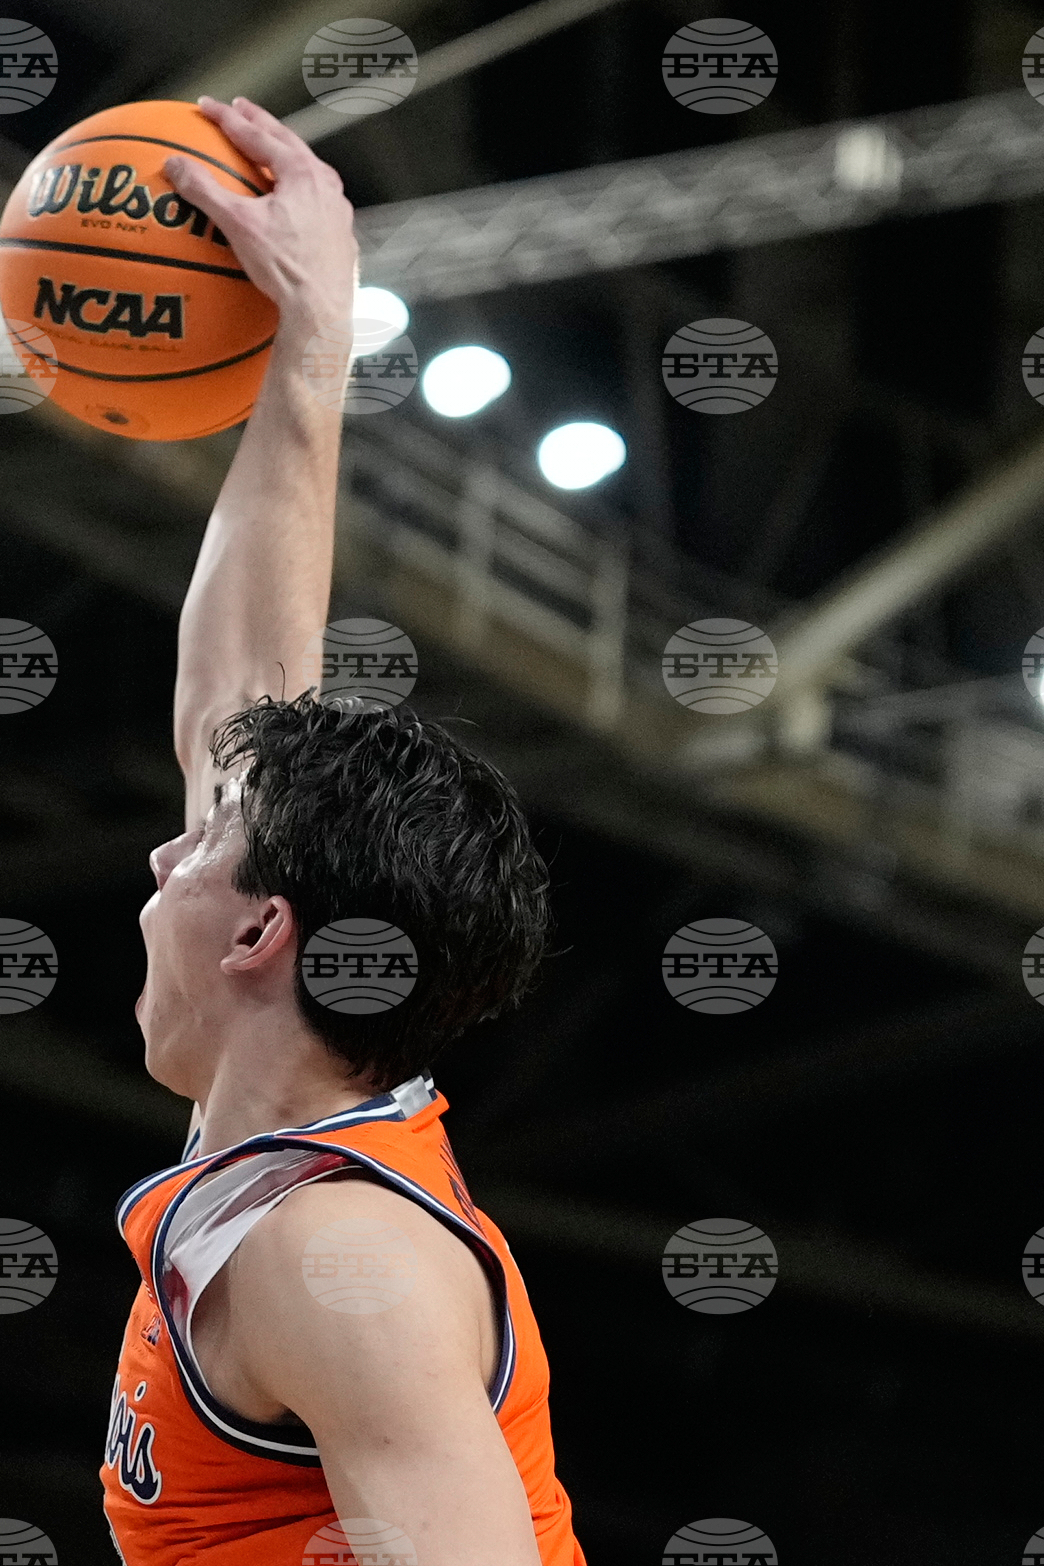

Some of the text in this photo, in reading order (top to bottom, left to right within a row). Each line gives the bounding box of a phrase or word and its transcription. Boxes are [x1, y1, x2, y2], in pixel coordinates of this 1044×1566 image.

[80, 218, 148, 235] EVO NXT
[33, 276, 185, 340] NCAA
